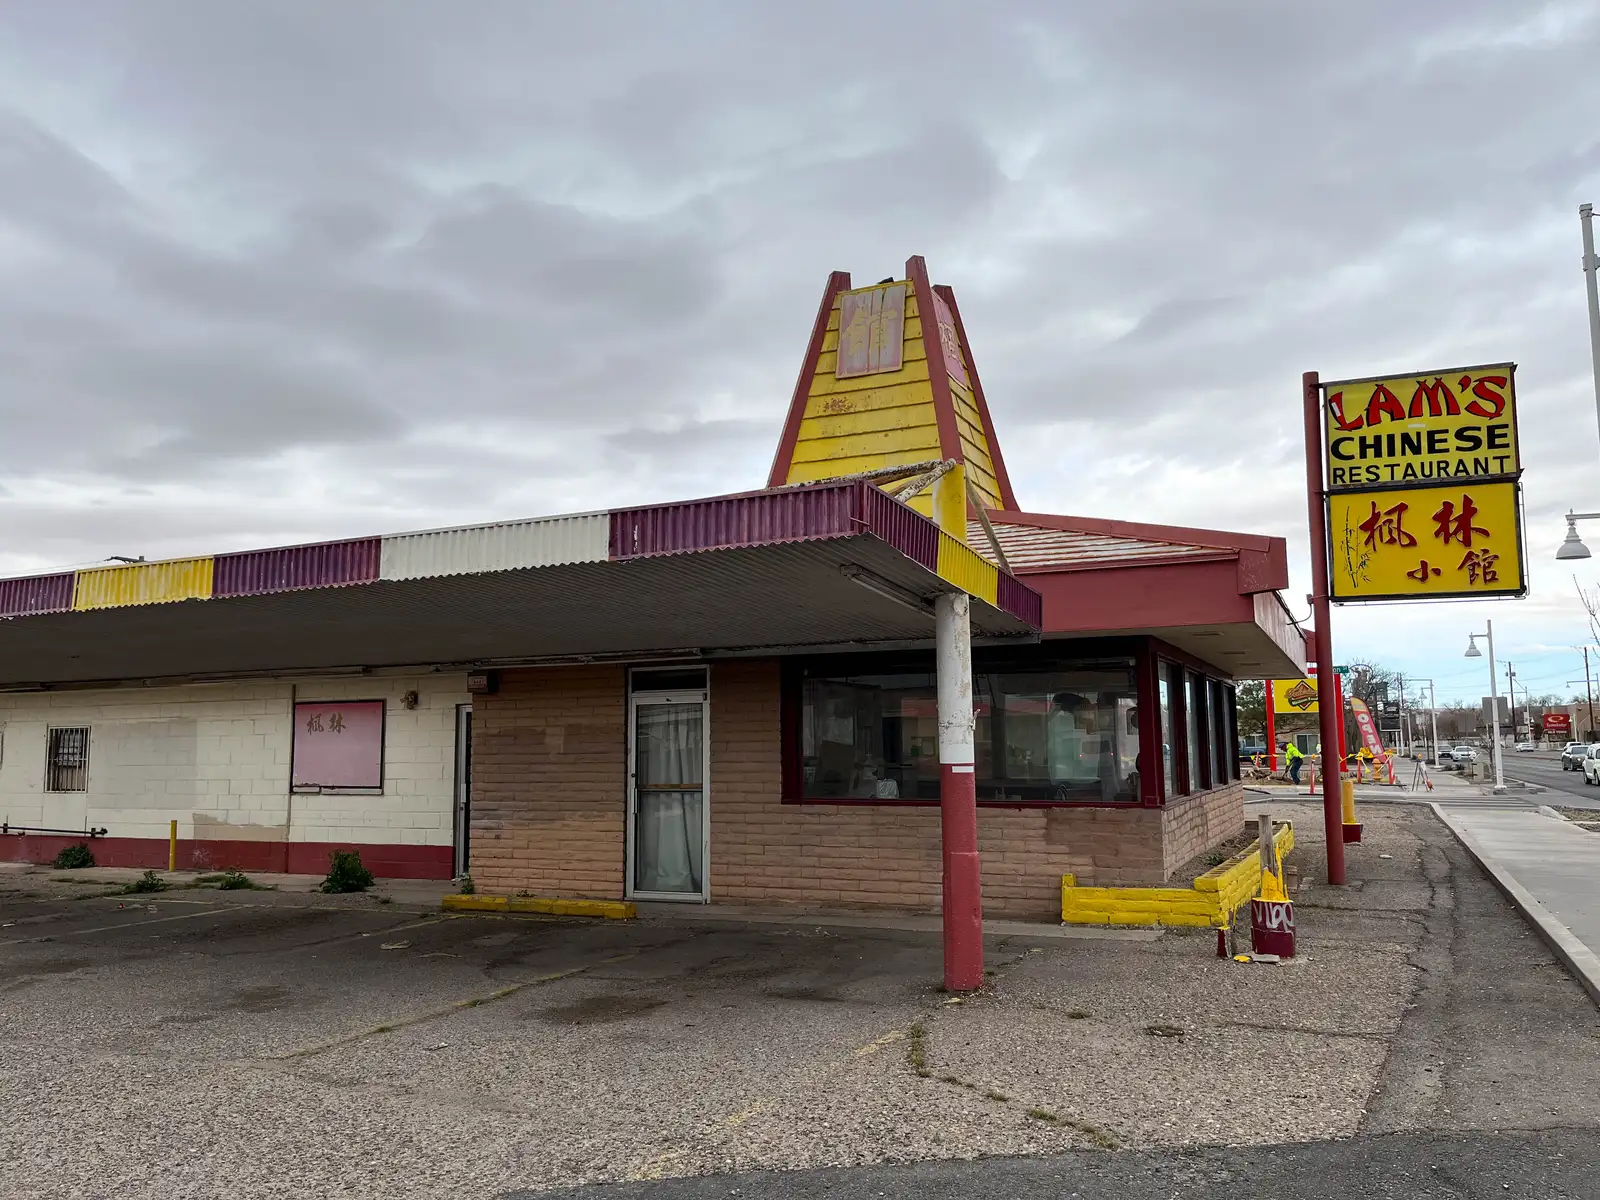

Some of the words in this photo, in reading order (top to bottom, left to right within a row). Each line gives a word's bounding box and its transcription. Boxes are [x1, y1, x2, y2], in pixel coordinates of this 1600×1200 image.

[1328, 374, 1508, 432] LAM'S
[1330, 423, 1510, 461] CHINESE
[1332, 455, 1511, 484] RESTAURANT
[1357, 713, 1382, 755] OPEN
